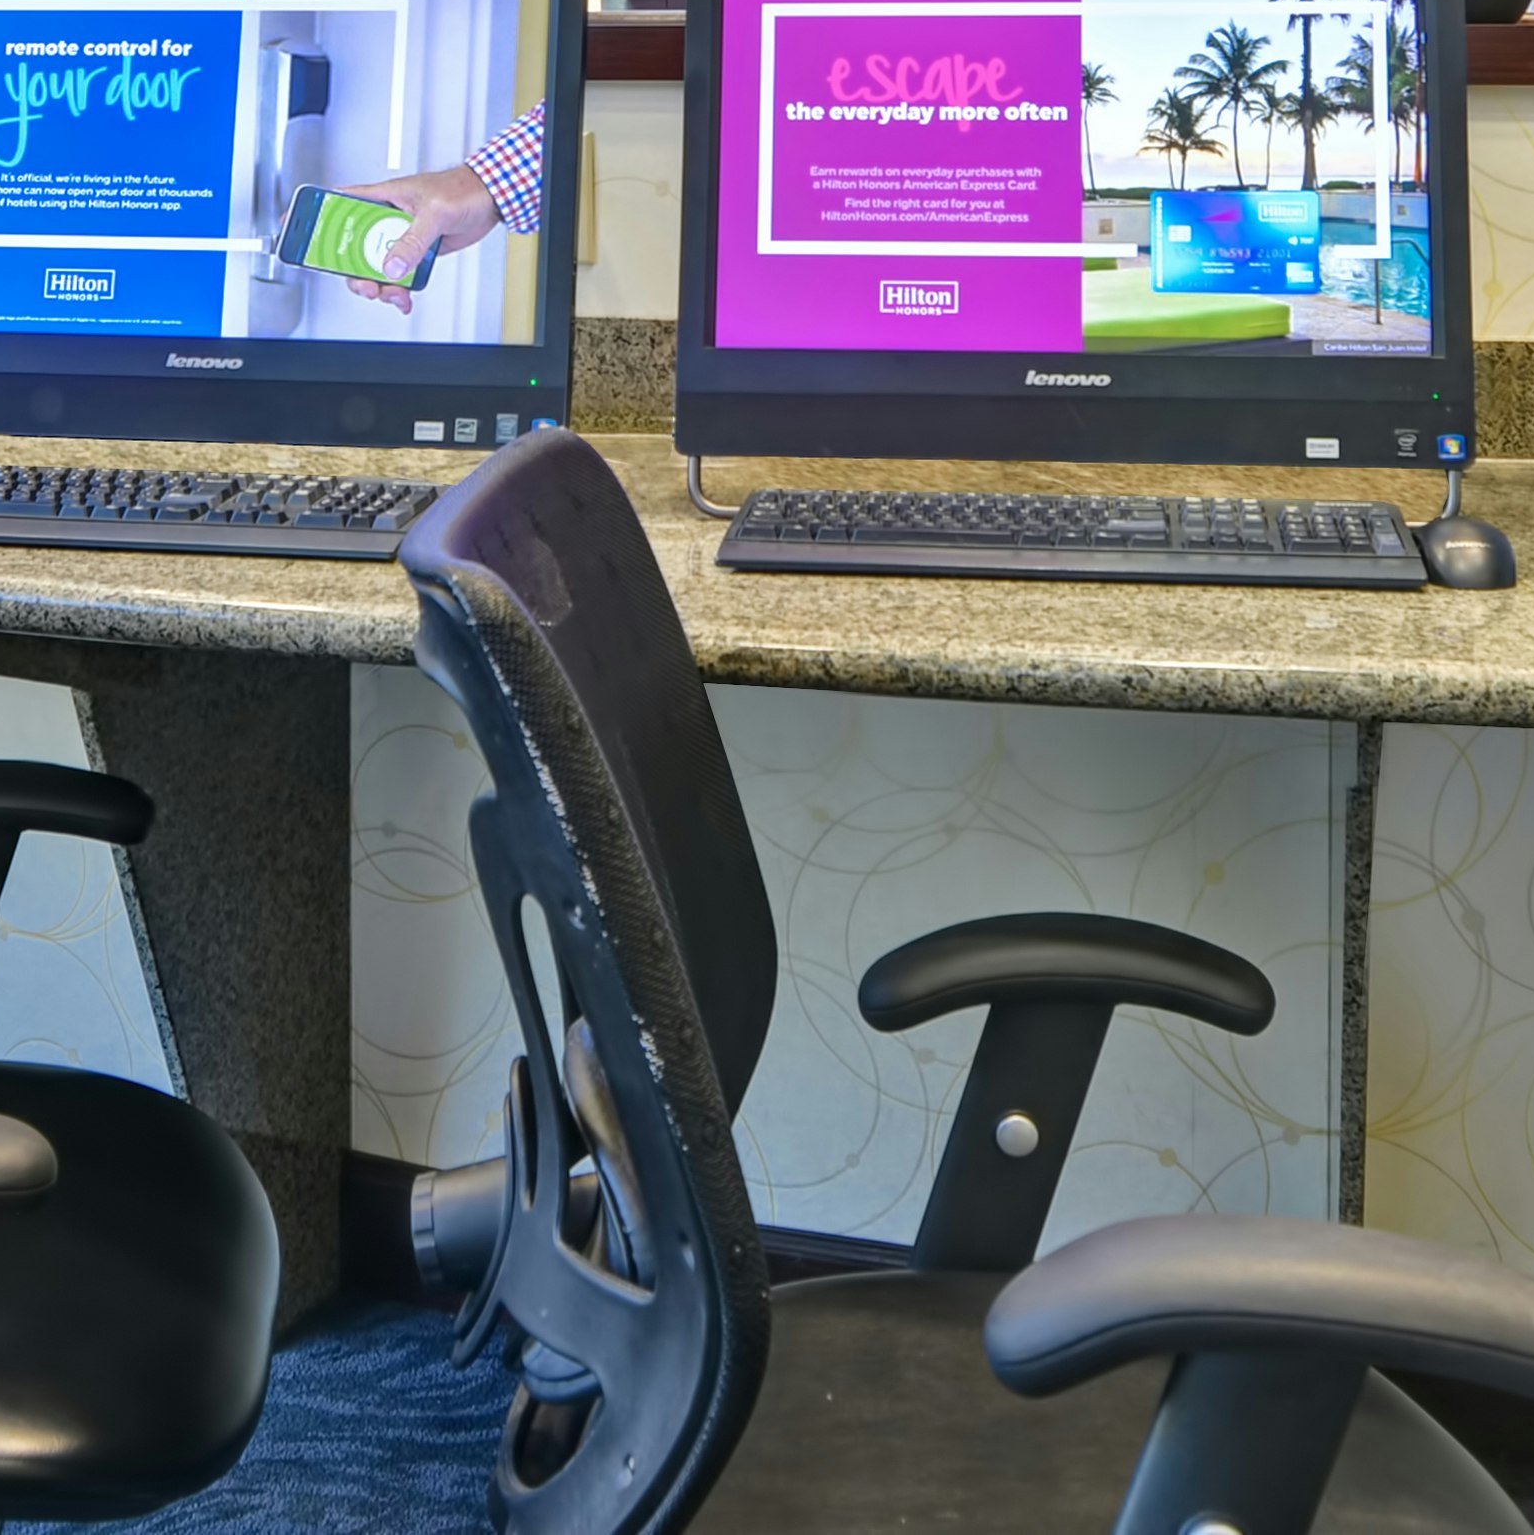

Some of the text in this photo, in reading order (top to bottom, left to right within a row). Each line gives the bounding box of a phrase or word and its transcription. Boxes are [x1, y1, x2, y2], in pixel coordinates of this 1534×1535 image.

[5, 39, 193, 56] remote control for
[105, 54, 202, 121] door
[826, 53, 1024, 132] escape
[785, 101, 1069, 125] the everyday more often
[809, 166, 1042, 179] Earn rewards on everyday purchases with
[55, 174, 81, 184] we're
[83, 174, 110, 186] living
[112, 175, 122, 184] in
[124, 175, 141, 185] the
[143, 175, 177, 185] future.
[812, 179, 1038, 192] a Hilton Honors American Express Card.
[24, 187, 43, 195] can
[44, 187, 66, 196] now
[67, 188, 93, 197] open
[95, 188, 118, 198] your
[120, 186, 144, 197] door
[146, 187, 157, 197] at
[159, 187, 214, 198] thousands
[6, 198, 38, 208] hotels
[39, 198, 67, 210] using
[69, 199, 86, 208] the
[88, 199, 119, 209] Hilton
[121, 200, 159, 210] Honors
[844, 197, 1005, 211] Find the right card for you at
[820, 211, 1029, 224] HiltonHonors.com/AmericanExpress
[50, 272, 109, 292] Hilton
[57, 293, 99, 302] HONORS
[886, 286, 952, 306] Hilton
[895, 306, 943, 316] HONORS
[165, 352, 244, 370] lenovo
[1024, 370, 1112, 387] lenovo
